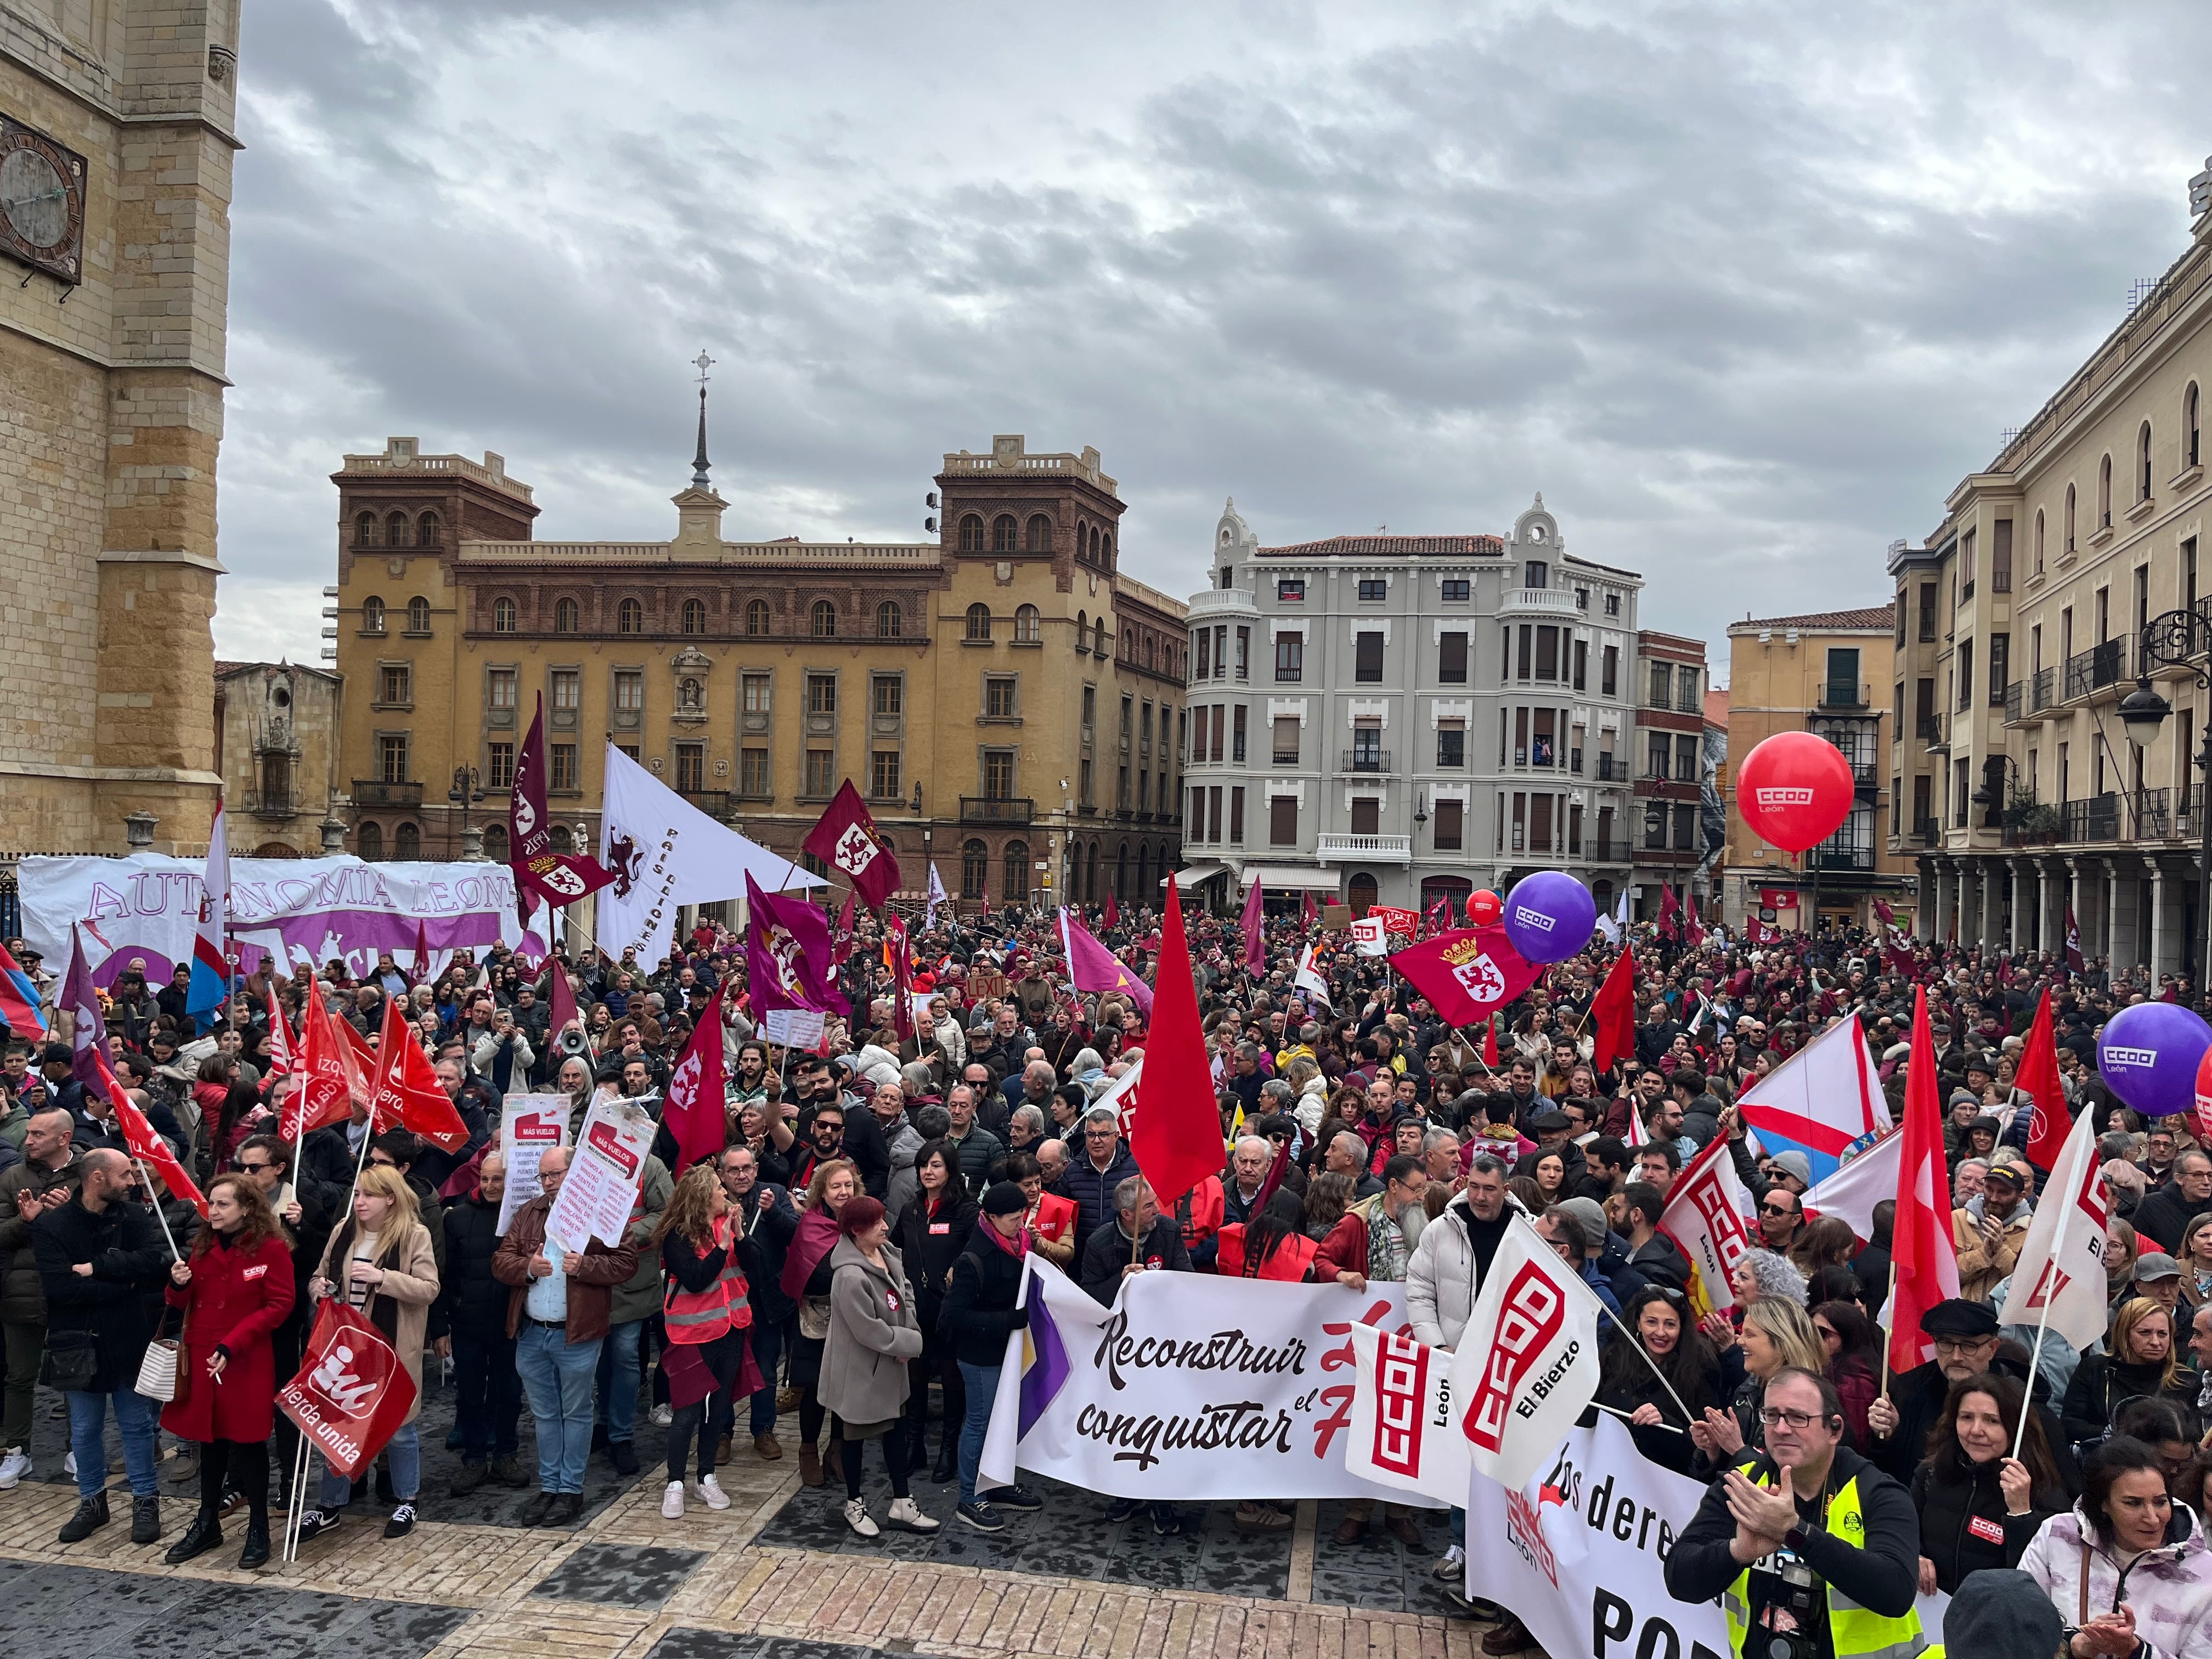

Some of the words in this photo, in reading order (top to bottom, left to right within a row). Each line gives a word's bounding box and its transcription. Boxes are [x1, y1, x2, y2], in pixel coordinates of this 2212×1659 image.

[1759, 791, 1810, 802] CCOO
[1514, 919, 1530, 930] León
[1517, 908, 1553, 929] CCOO
[967, 976, 1005, 997] LEXIT
[2106, 1049, 2152, 1064] CCOO
[2106, 1064, 2127, 1073] León
[523, 1127, 535, 1135] MÁS
[596, 1136, 608, 1148] MÁS
[608, 1143, 630, 1163] VUELOS
[580, 1165, 599, 1183] MINISTRO
[608, 1159, 618, 1169] PARA
[570, 1178, 597, 1203] COMPROMISO
[576, 1173, 591, 1188] PUENTE
[564, 1195, 583, 1215] TERMINAL
[566, 1187, 579, 1199] FIRME
[578, 1197, 588, 1206] CON
[574, 1225, 582, 1233] DE
[1698, 1181, 1748, 1282] CCO
[1700, 1233, 1716, 1273] León
[1094, 1307, 1307, 1391] Reconstruir
[1473, 1272, 1559, 1443] CCOO
[1515, 1394, 1538, 1420] El
[1531, 1340, 1580, 1401] Bierzo
[1434, 1377, 1450, 1427] León
[1077, 1401, 1293, 1471] conquistar
[1295, 1388, 1319, 1413] el
[316, 1422, 361, 1465] unida
[1543, 1441, 1583, 1513] los
[1587, 1474, 1678, 1564] dere
[1972, 1517, 2004, 1537] CCOO
[1507, 1520, 1538, 1572] León
